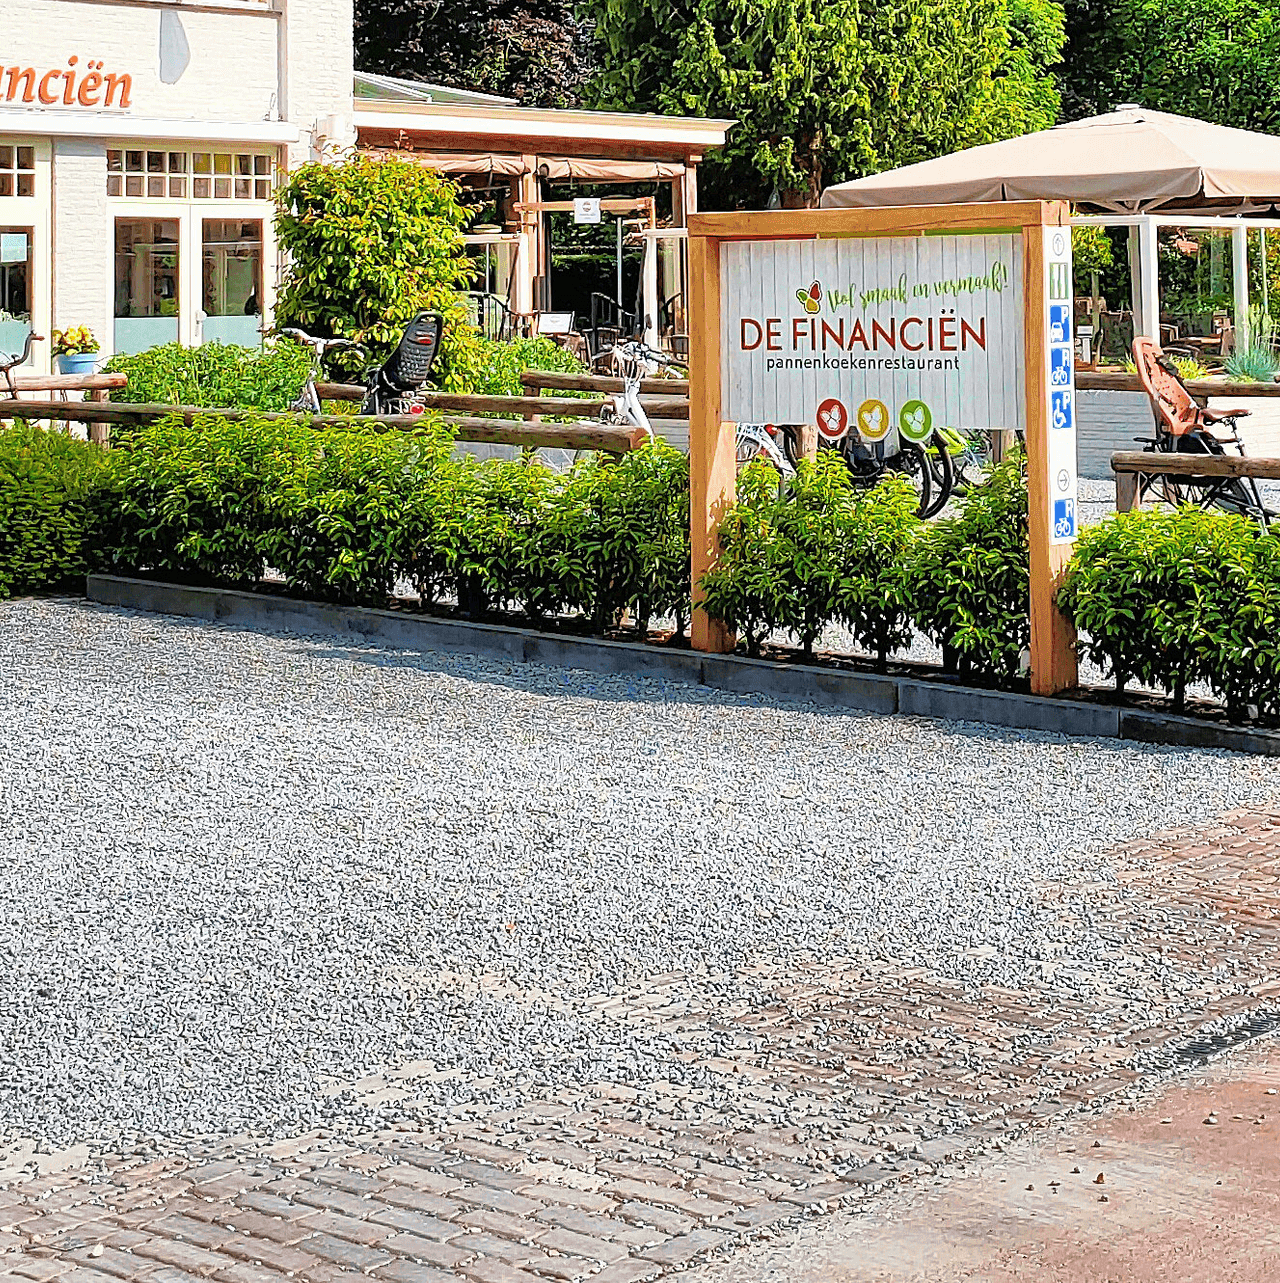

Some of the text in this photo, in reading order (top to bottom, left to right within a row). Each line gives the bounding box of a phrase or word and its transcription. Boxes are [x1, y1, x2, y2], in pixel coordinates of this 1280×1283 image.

[740, 308, 987, 352] DE FINANCIËN
[766, 352, 961, 372] pannenkoekenrestaurant
